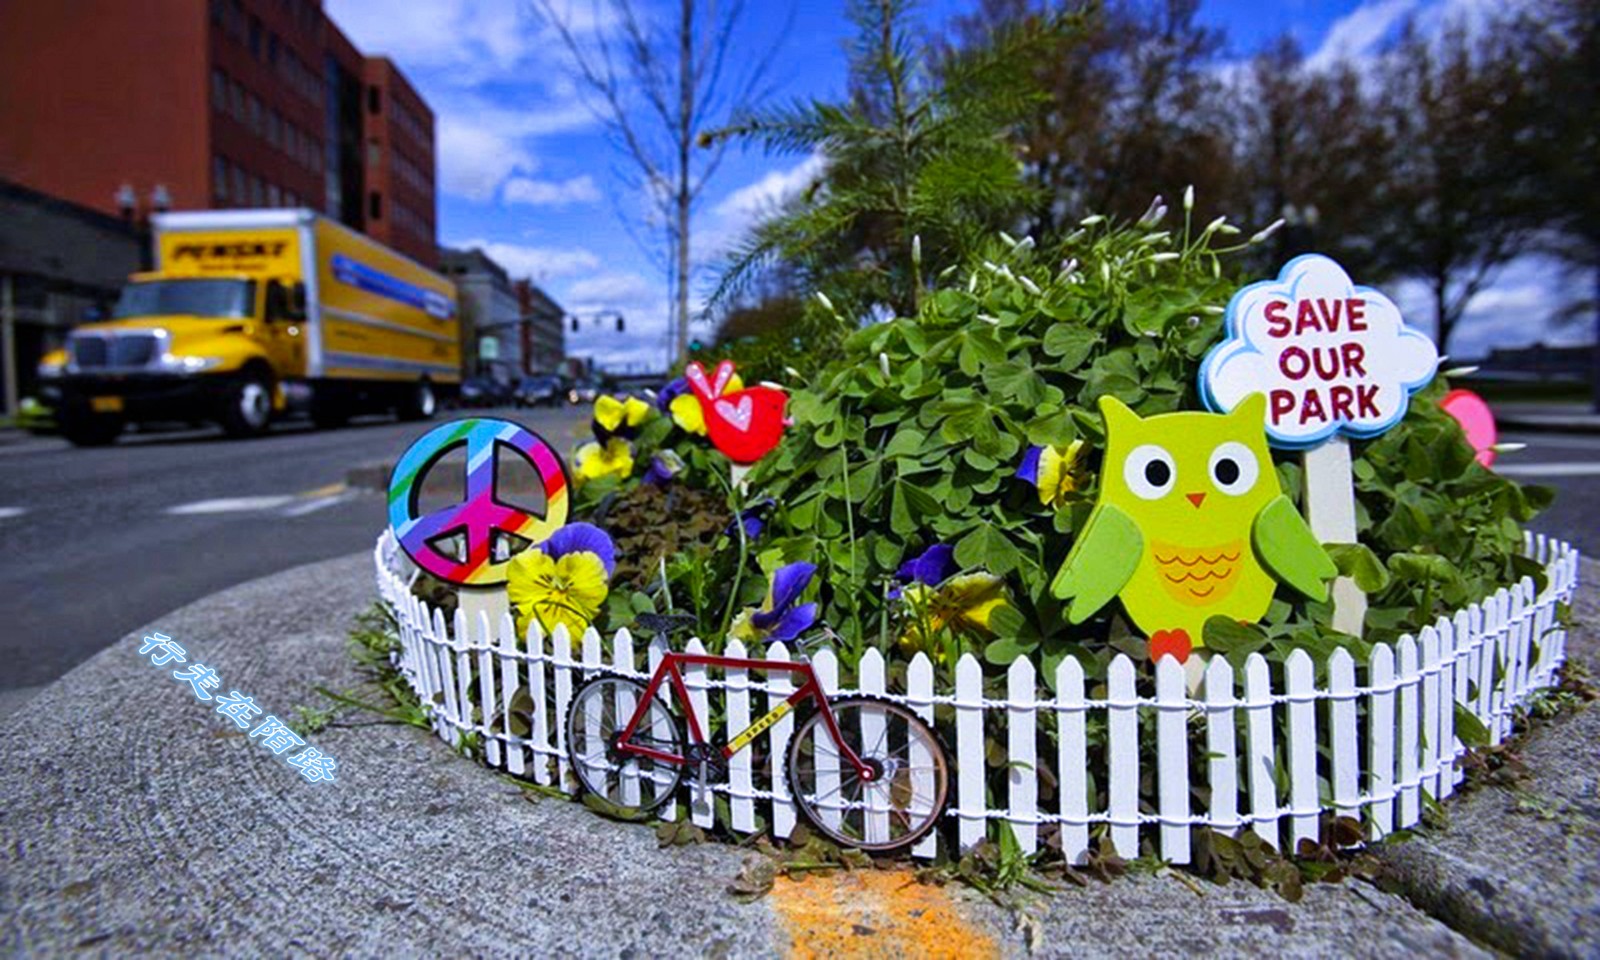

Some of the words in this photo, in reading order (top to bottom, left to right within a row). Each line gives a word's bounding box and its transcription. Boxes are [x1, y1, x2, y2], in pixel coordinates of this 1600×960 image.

[1264, 298, 1368, 338] SAVE
[1278, 342, 1366, 381] OUR
[1270, 384, 1380, 426] PARK
[744, 711, 780, 740] SPEED
